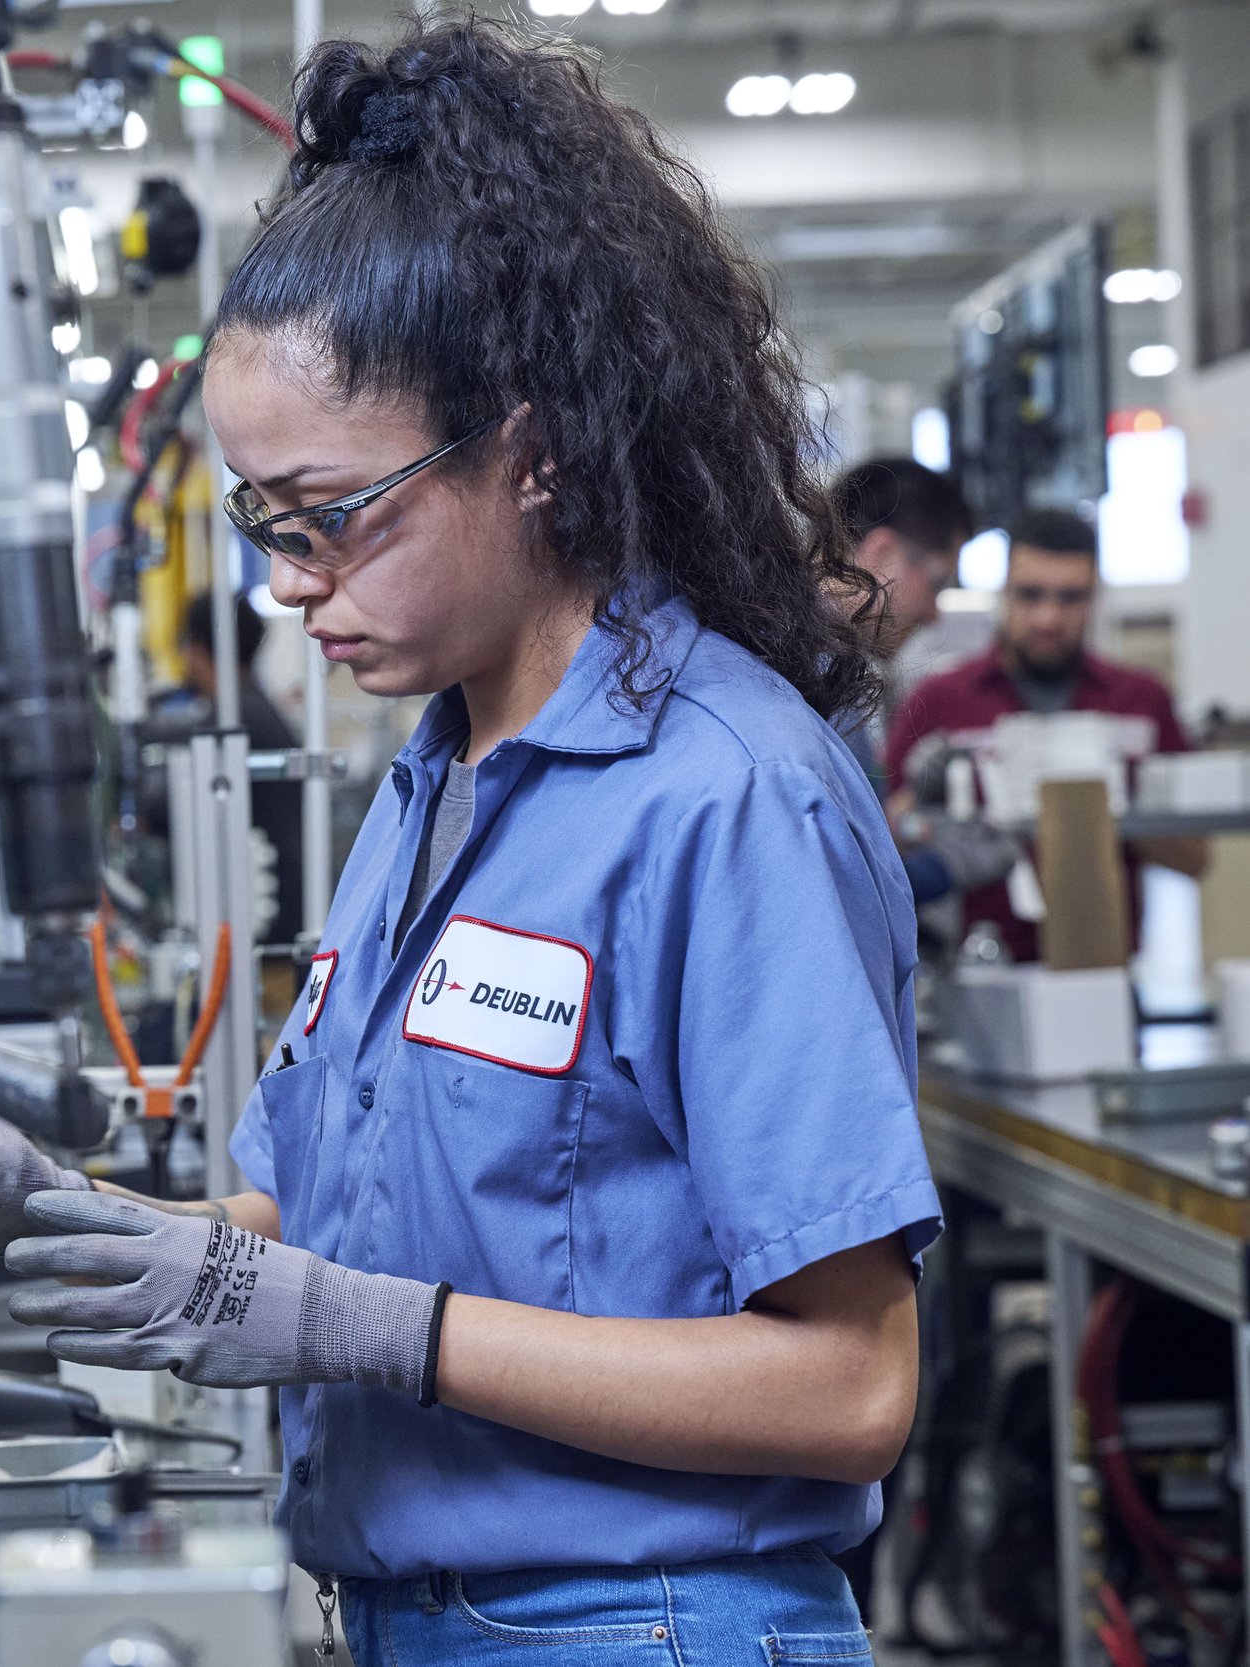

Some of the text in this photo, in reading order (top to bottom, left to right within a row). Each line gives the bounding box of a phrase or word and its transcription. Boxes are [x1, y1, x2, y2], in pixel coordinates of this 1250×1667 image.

[469, 982, 577, 1026] DEUBLIN
[181, 1219, 223, 1320] Body Guar
[195, 1251, 228, 1327] SAFETY
